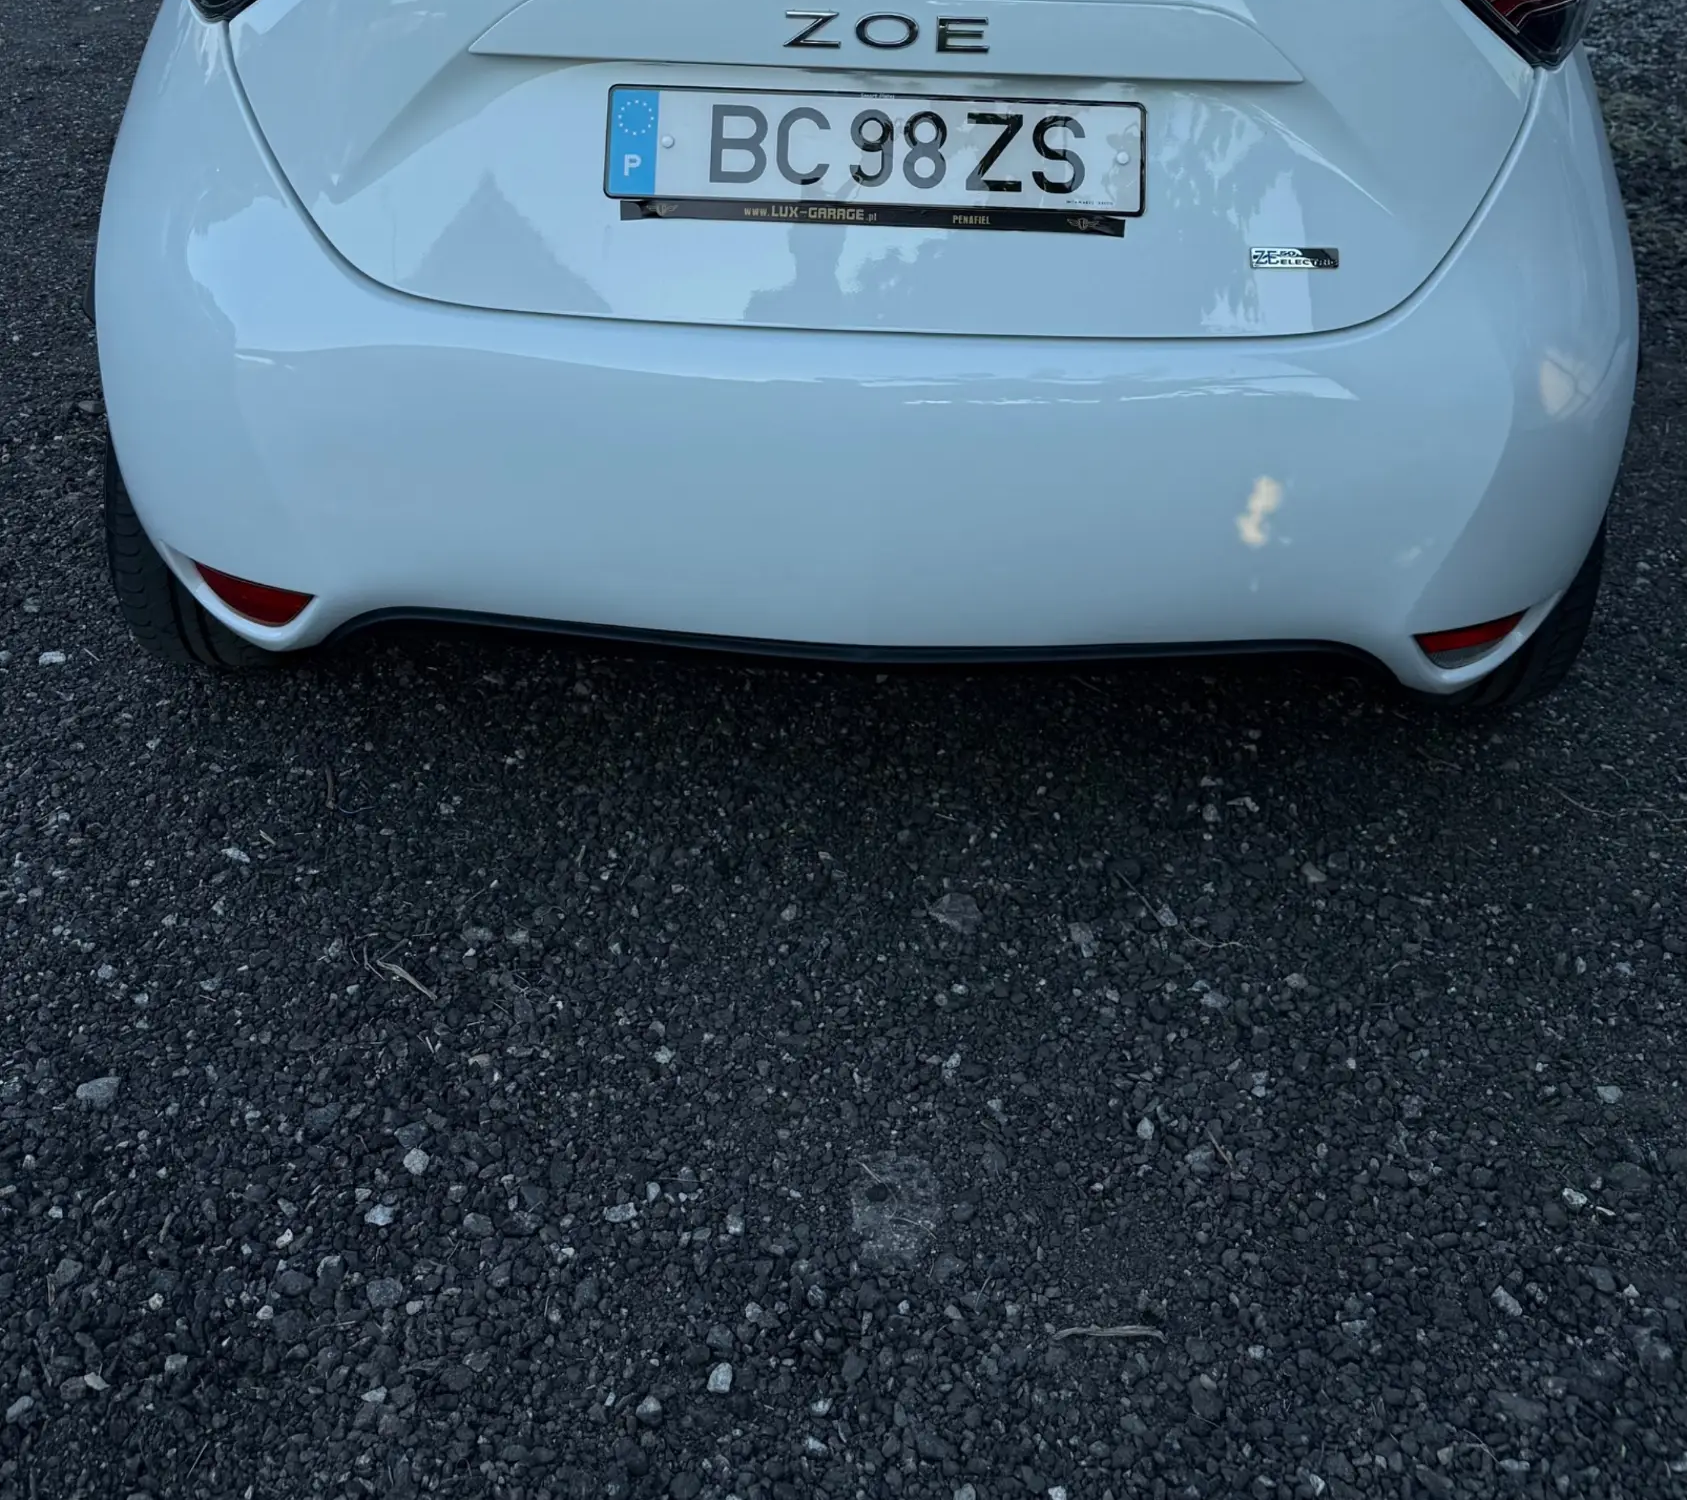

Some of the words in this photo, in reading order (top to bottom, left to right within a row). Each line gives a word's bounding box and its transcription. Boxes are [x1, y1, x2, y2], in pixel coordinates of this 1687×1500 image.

[783, 10, 990, 54] ZOE
[623, 153, 642, 177] P
[709, 103, 831, 186] BC
[850, 108, 948, 189] 98
[965, 112, 1086, 194] ZS
[952, 213, 991, 226] PENAFIEL
